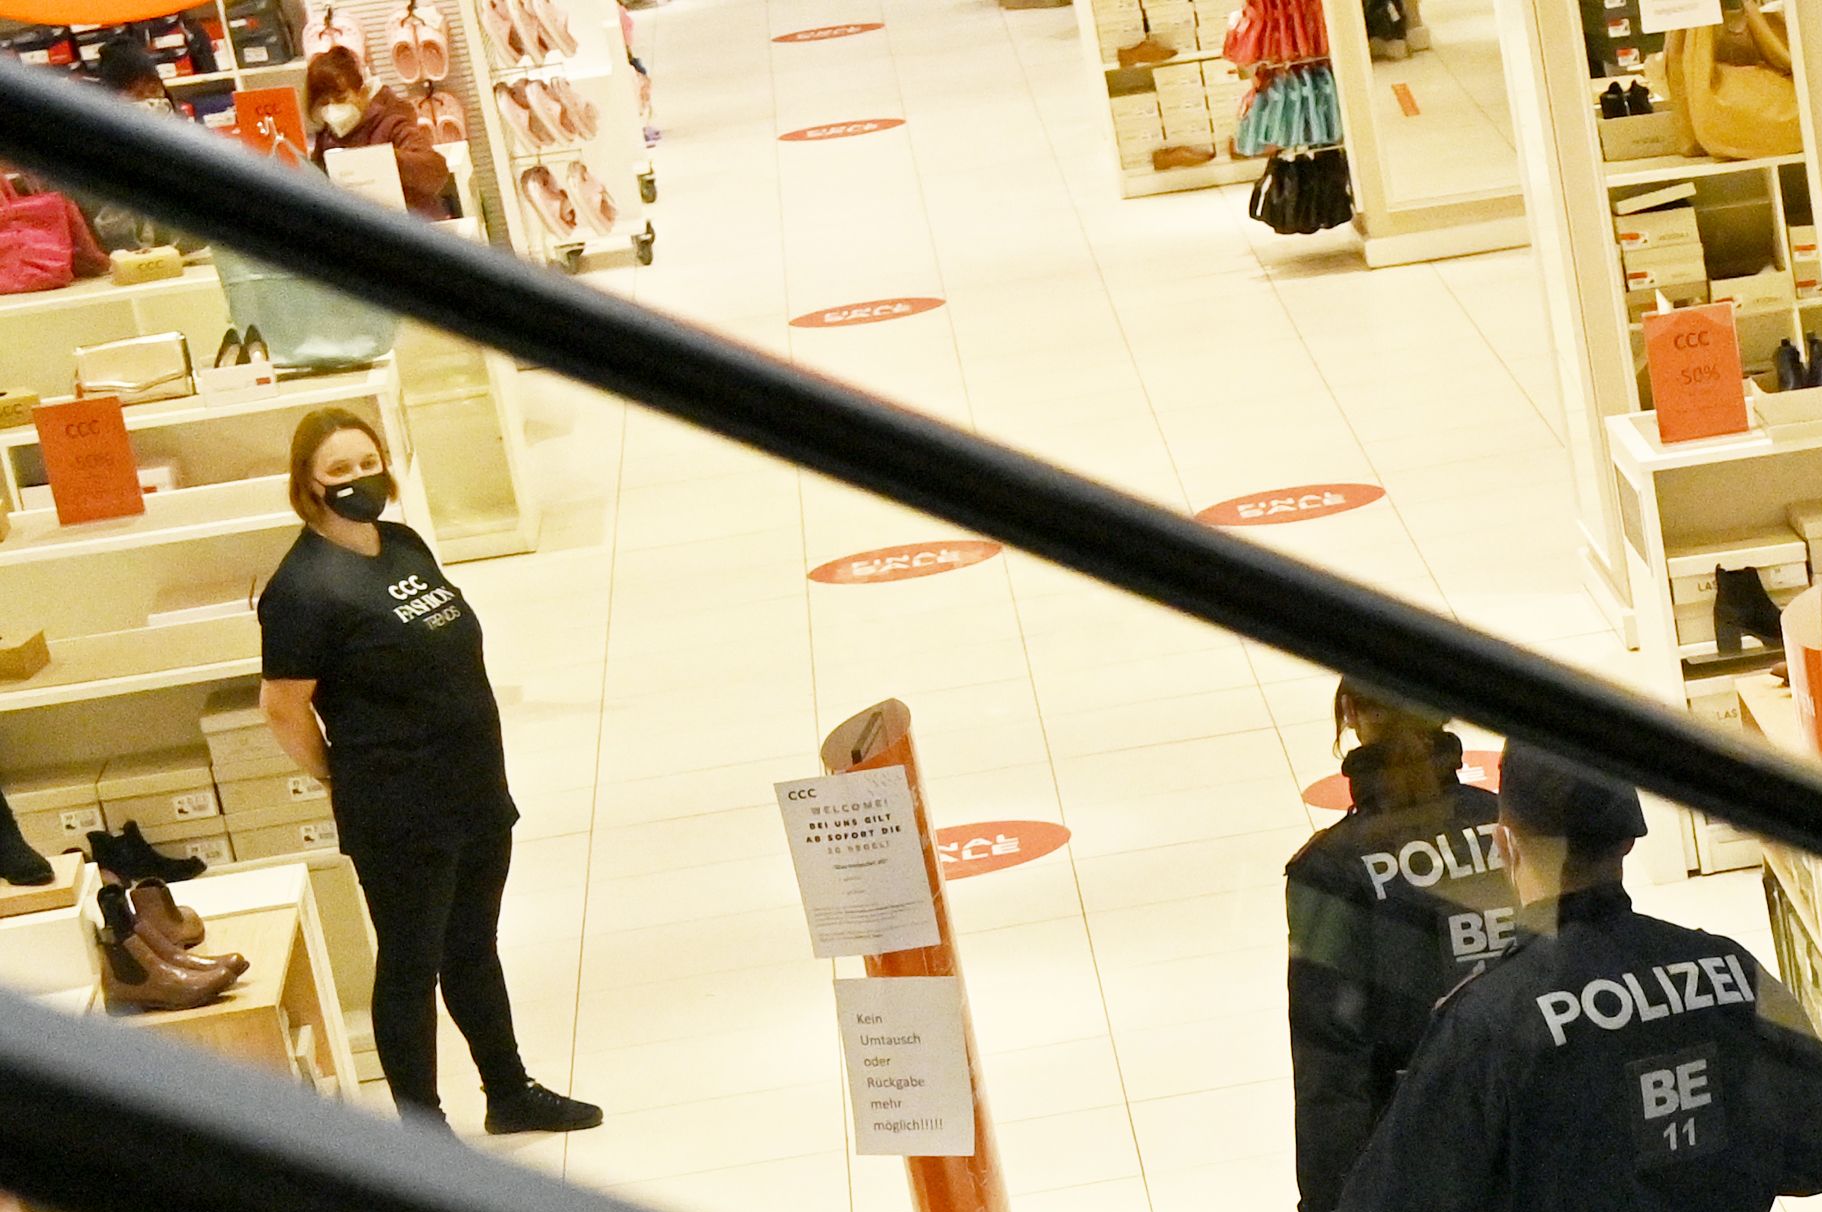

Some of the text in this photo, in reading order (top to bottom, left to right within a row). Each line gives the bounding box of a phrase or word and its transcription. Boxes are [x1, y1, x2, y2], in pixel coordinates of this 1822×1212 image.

[1674, 331, 1709, 350] CCC
[65, 420, 100, 439] CCC
[387, 574, 428, 600] CCC
[393, 586, 455, 623] FASHION
[788, 788, 817, 801] CCC
[811, 799, 889, 815] WELCOME!
[809, 813, 892, 831] BEI UNS GILT
[806, 825, 902, 844] AB SOFORT DIE
[1448, 907, 1518, 958] BE
[1535, 954, 1756, 1047] POLIZEI
[856, 1013, 883, 1025] Kein
[860, 1033, 921, 1046] Umtausch
[863, 1056, 891, 1067] oder
[866, 1076, 926, 1090] Rückgabe
[1639, 1058, 1712, 1120] BE
[870, 1096, 902, 1109] mehr
[1662, 1117, 1697, 1151] 11
